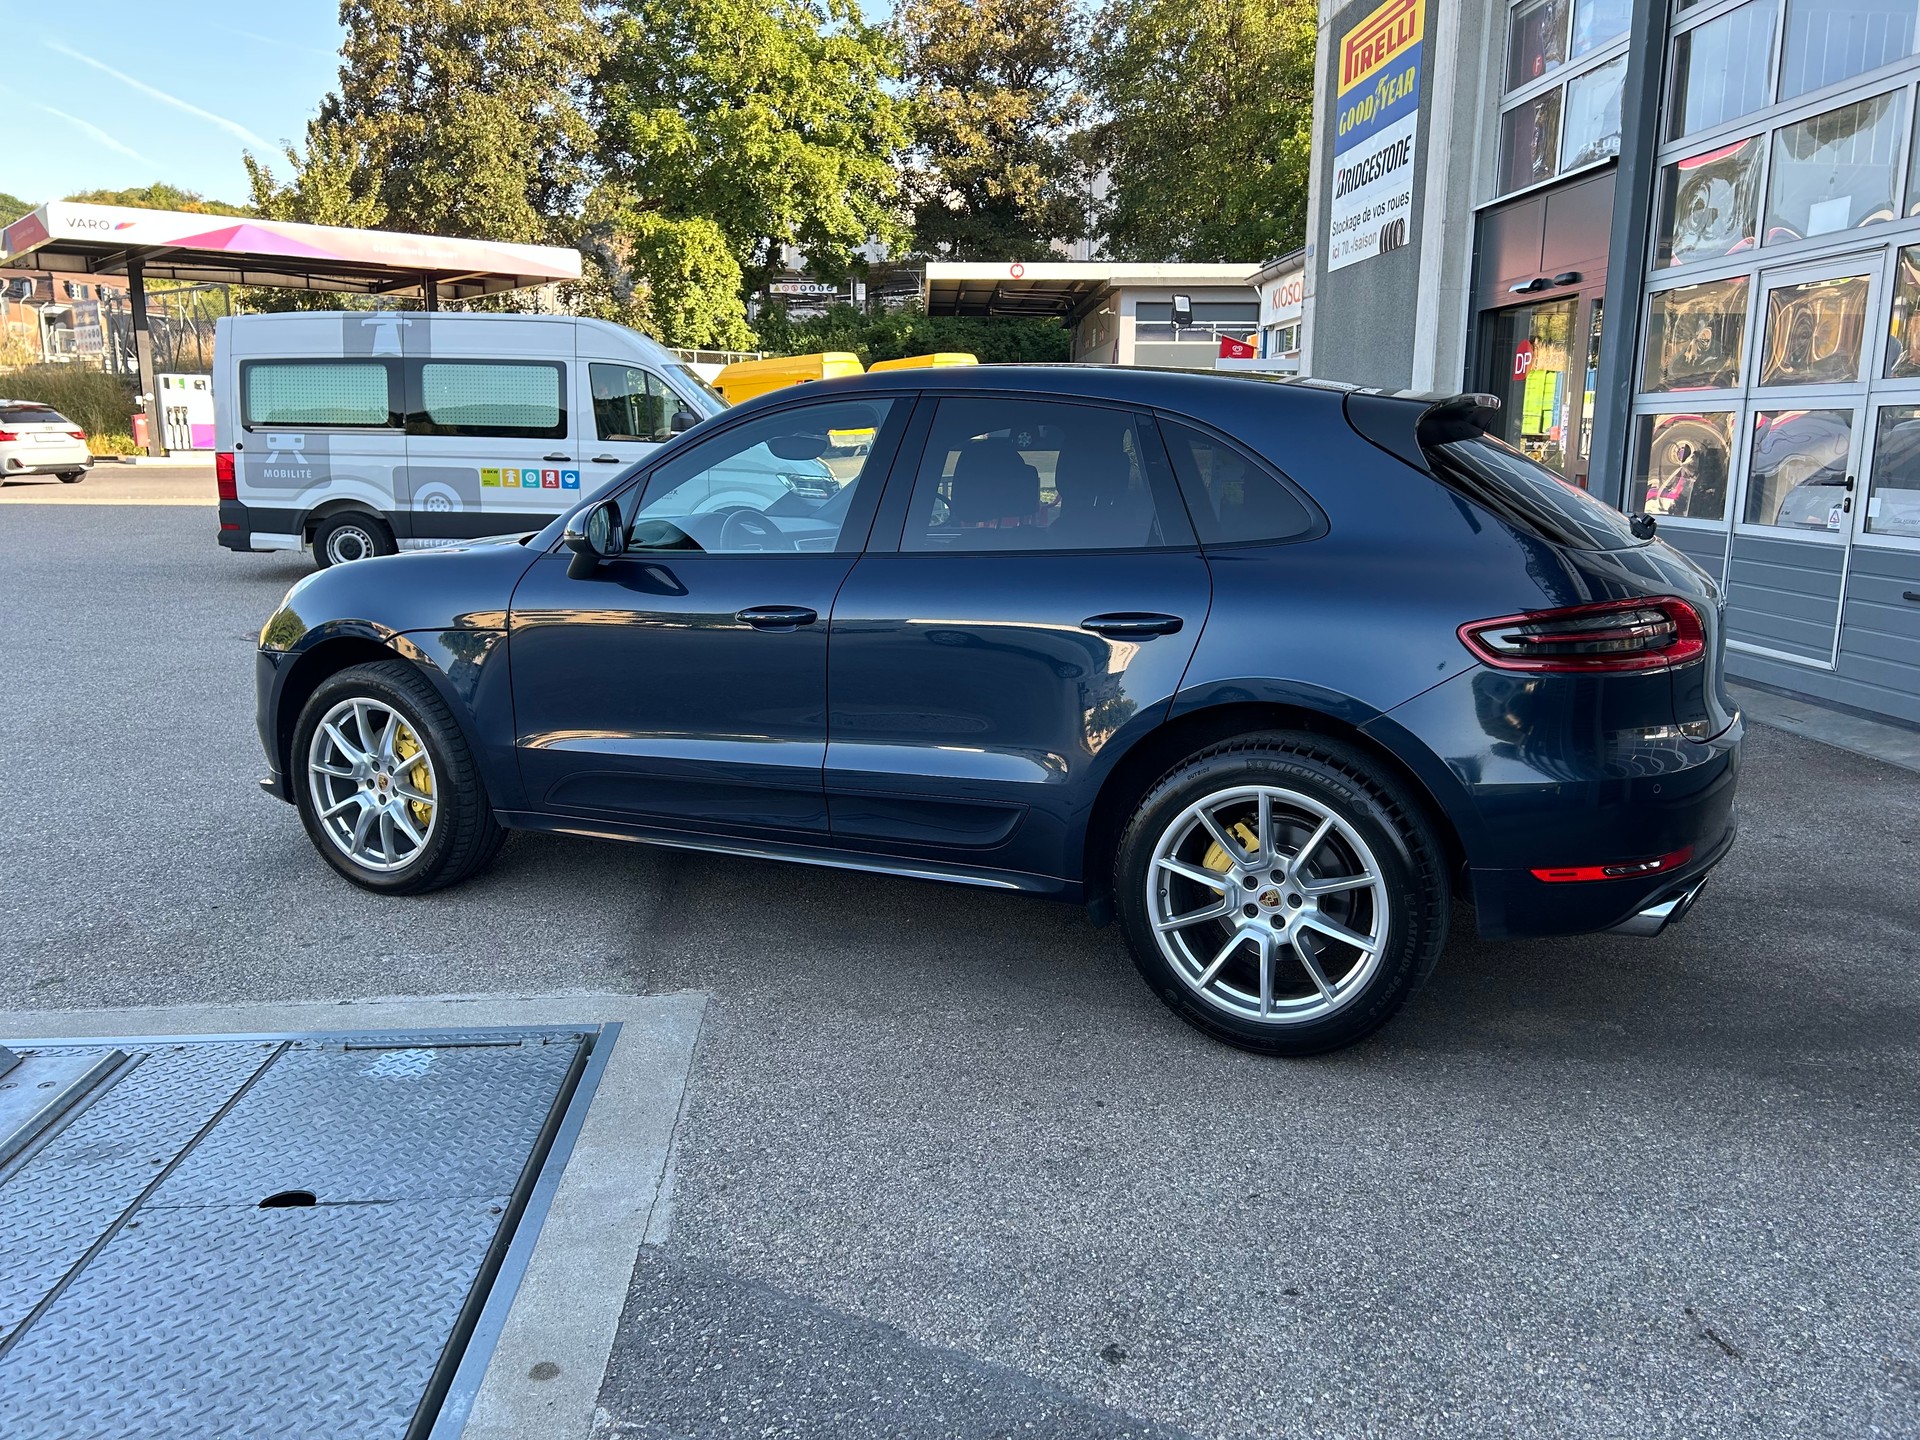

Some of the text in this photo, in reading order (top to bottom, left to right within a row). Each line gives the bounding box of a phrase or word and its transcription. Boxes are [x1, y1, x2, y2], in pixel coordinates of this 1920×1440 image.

[1344, 0, 1417, 87] PIRELLI
[1335, 134, 1412, 200] BRIDGESTONE
[66, 217, 110, 230] VARO
[1331, 191, 1410, 237] Stockage de vos roues
[1332, 243, 1340, 260] ici
[1272, 281, 1301, 310] KIOSQ
[263, 468, 312, 479] MOBILITÉ
[419, 540, 463, 548] TELECO
[1268, 761, 1352, 798] MICHELIN
[1398, 910, 1419, 976] LATITUDE
